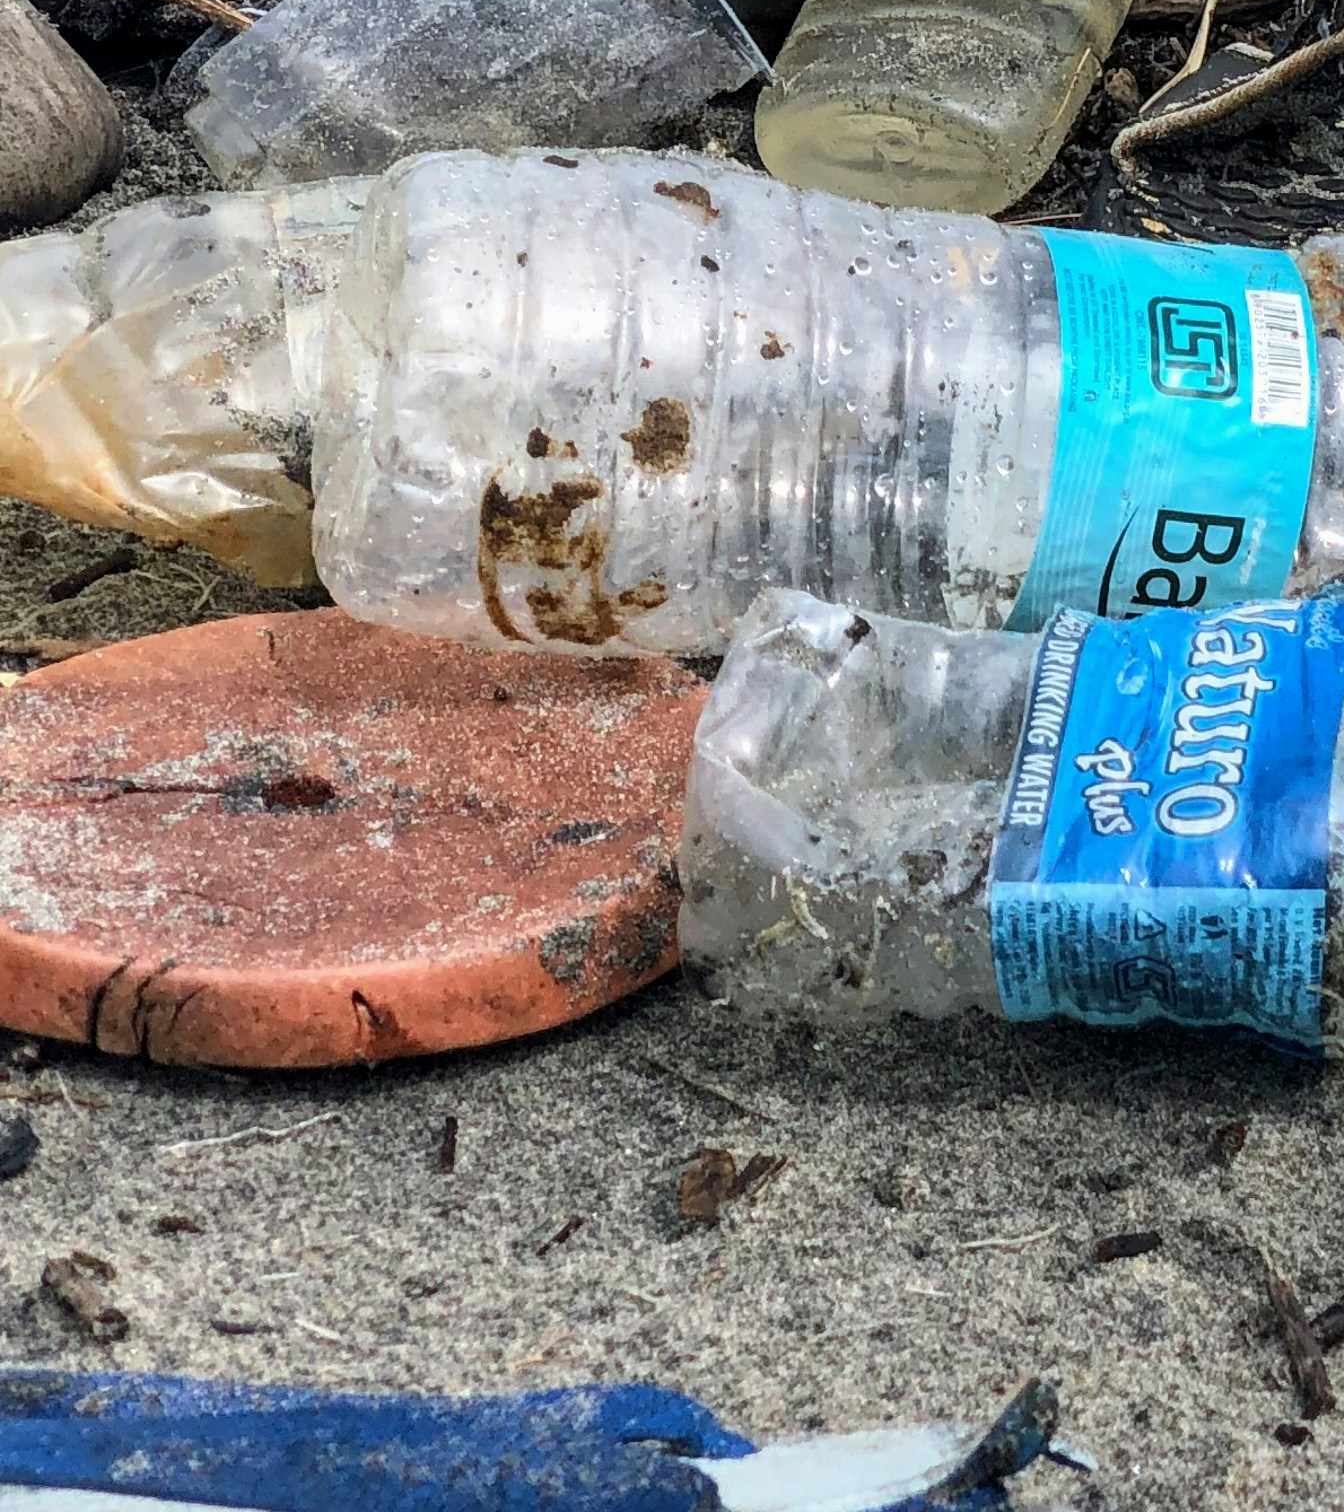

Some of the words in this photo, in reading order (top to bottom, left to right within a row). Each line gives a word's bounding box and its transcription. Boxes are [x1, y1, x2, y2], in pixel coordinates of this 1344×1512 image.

[1124, 508, 1246, 619] Ba
[1027, 639, 1080, 748] DRINKING
[1009, 753, 1056, 826] WATER
[1074, 739, 1151, 836] plus
